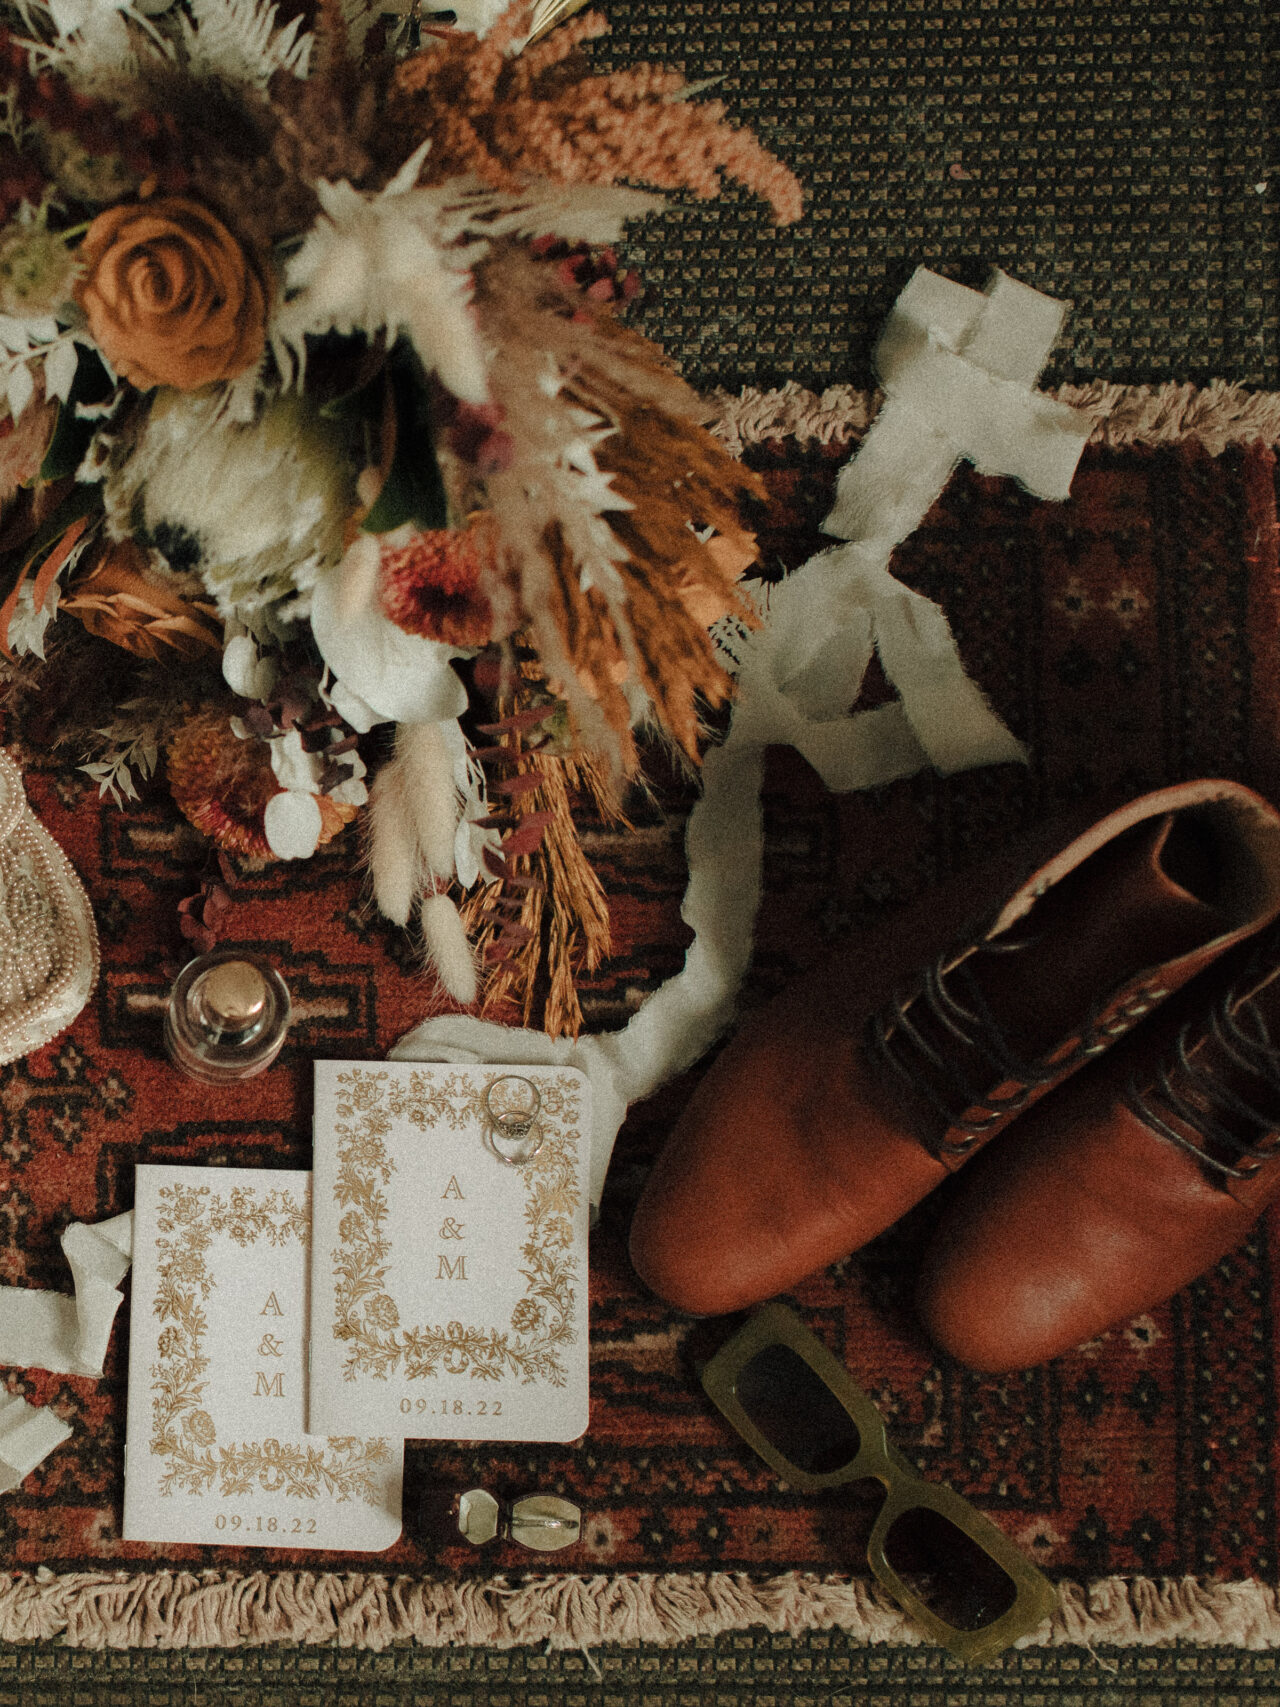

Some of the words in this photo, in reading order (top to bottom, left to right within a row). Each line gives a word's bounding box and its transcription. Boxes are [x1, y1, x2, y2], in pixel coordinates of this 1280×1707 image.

[440, 1174, 466, 1200] A
[439, 1216, 466, 1241] &
[435, 1255, 469, 1281] M
[259, 1290, 284, 1317] A
[257, 1333, 284, 1358] &
[252, 1371, 286, 1398] M
[399, 1398, 504, 1417] 09.18.22
[214, 1514, 319, 1534] 09.18.22
